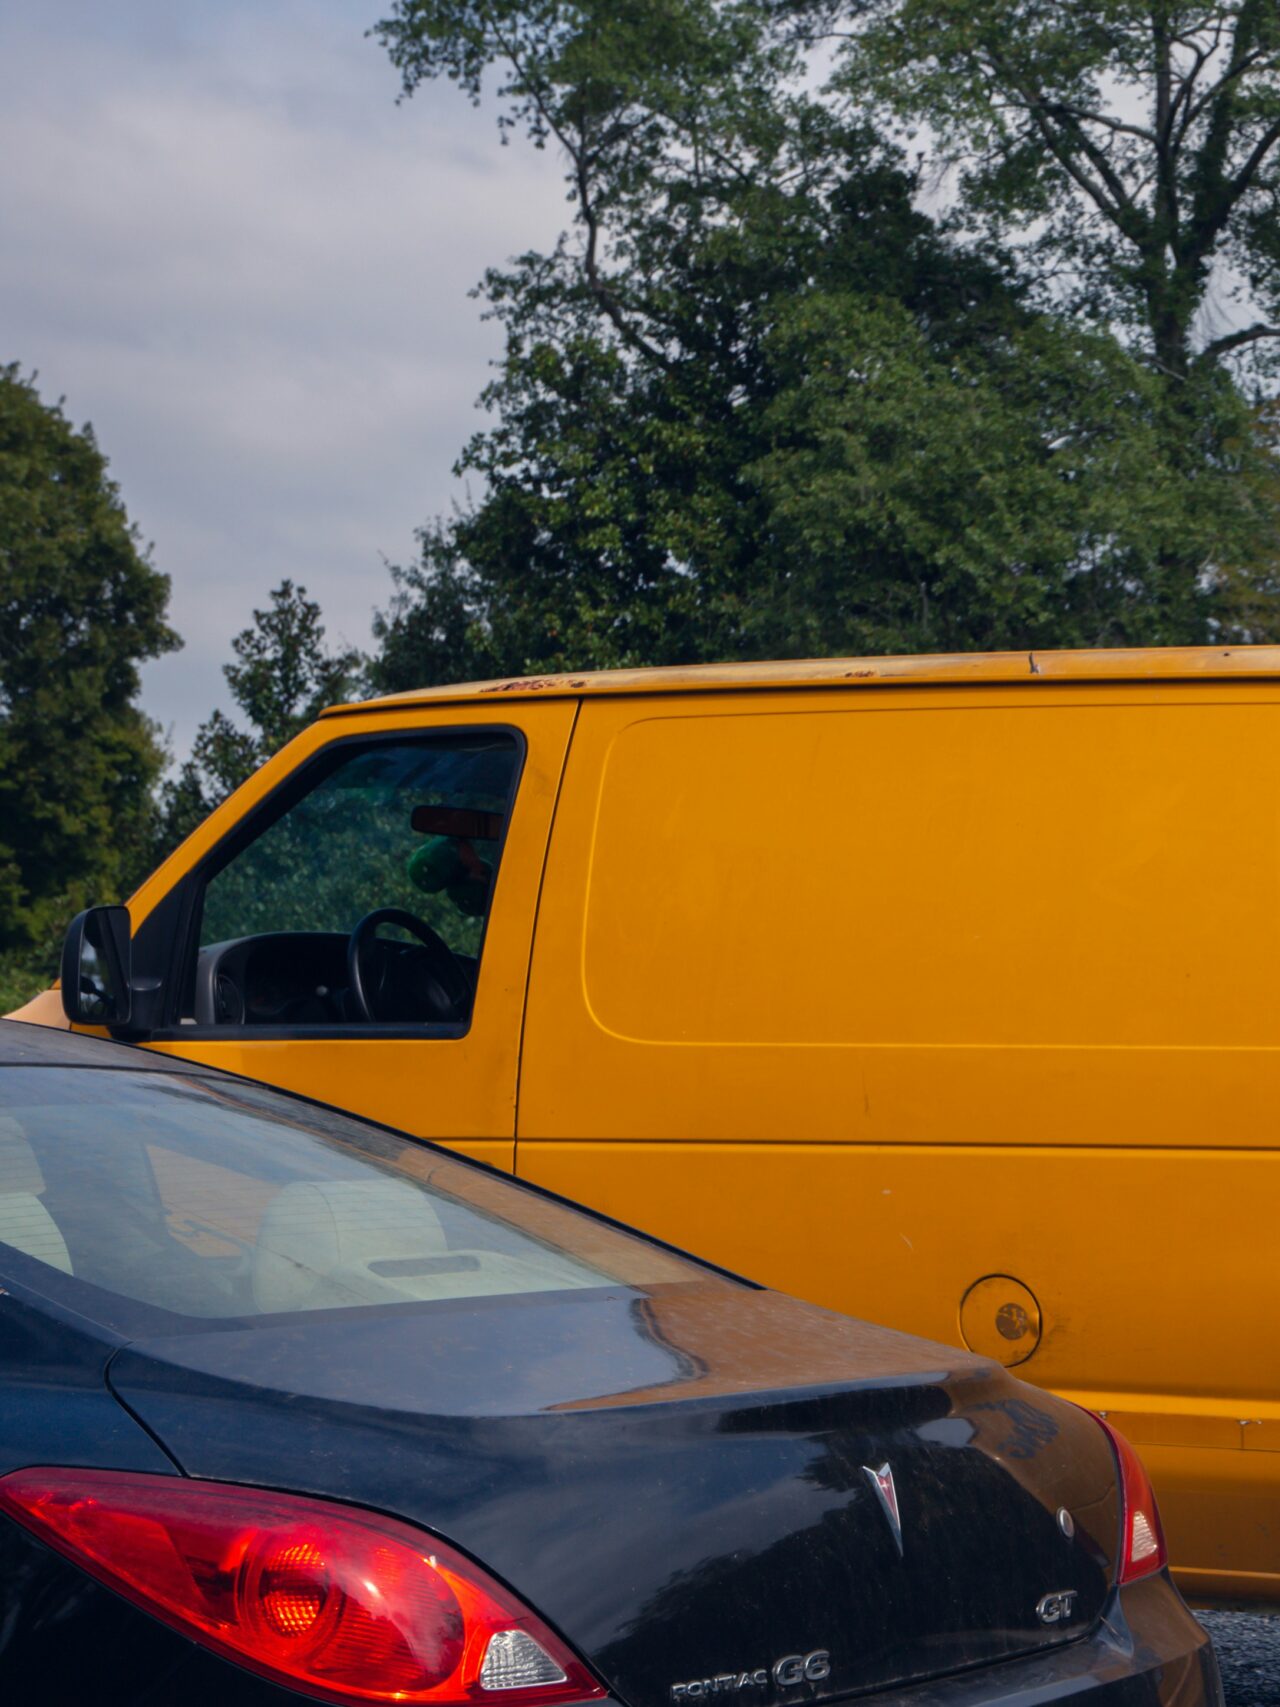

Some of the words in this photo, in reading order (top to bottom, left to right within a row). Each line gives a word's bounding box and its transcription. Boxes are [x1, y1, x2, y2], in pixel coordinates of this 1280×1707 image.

[1035, 1590, 1078, 1623] GT
[670, 1669, 768, 1701] PONTIAC
[771, 1649, 832, 1687] G6
